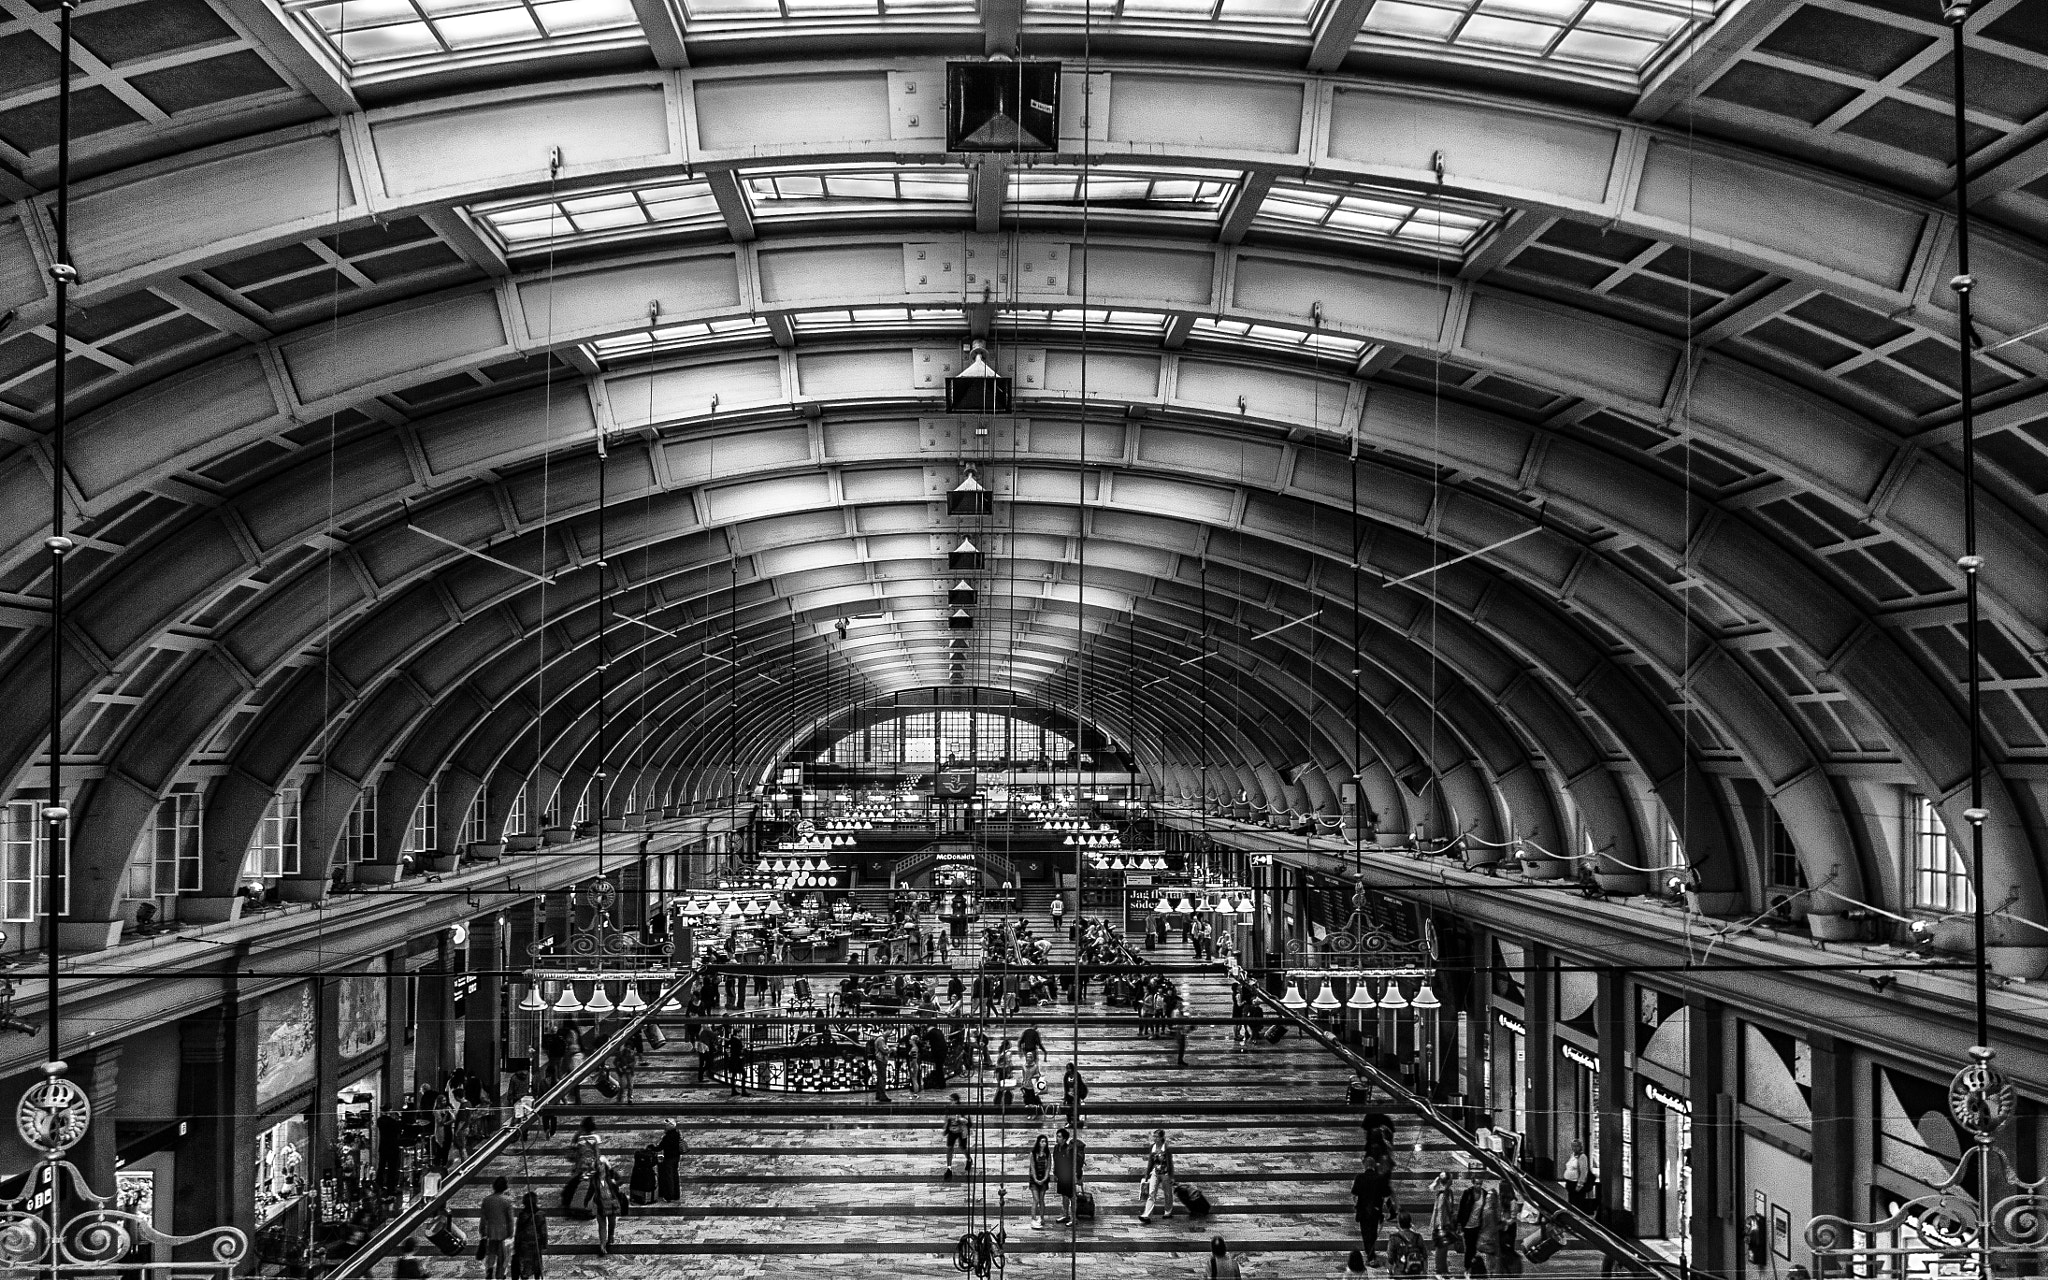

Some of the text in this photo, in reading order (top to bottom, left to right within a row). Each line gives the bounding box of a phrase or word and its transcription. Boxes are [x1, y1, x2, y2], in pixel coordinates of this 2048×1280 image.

[950, 774, 961, 784] SJ
[1130, 890, 1150, 900] Jag
[1037, 1081, 1046, 1091] C
